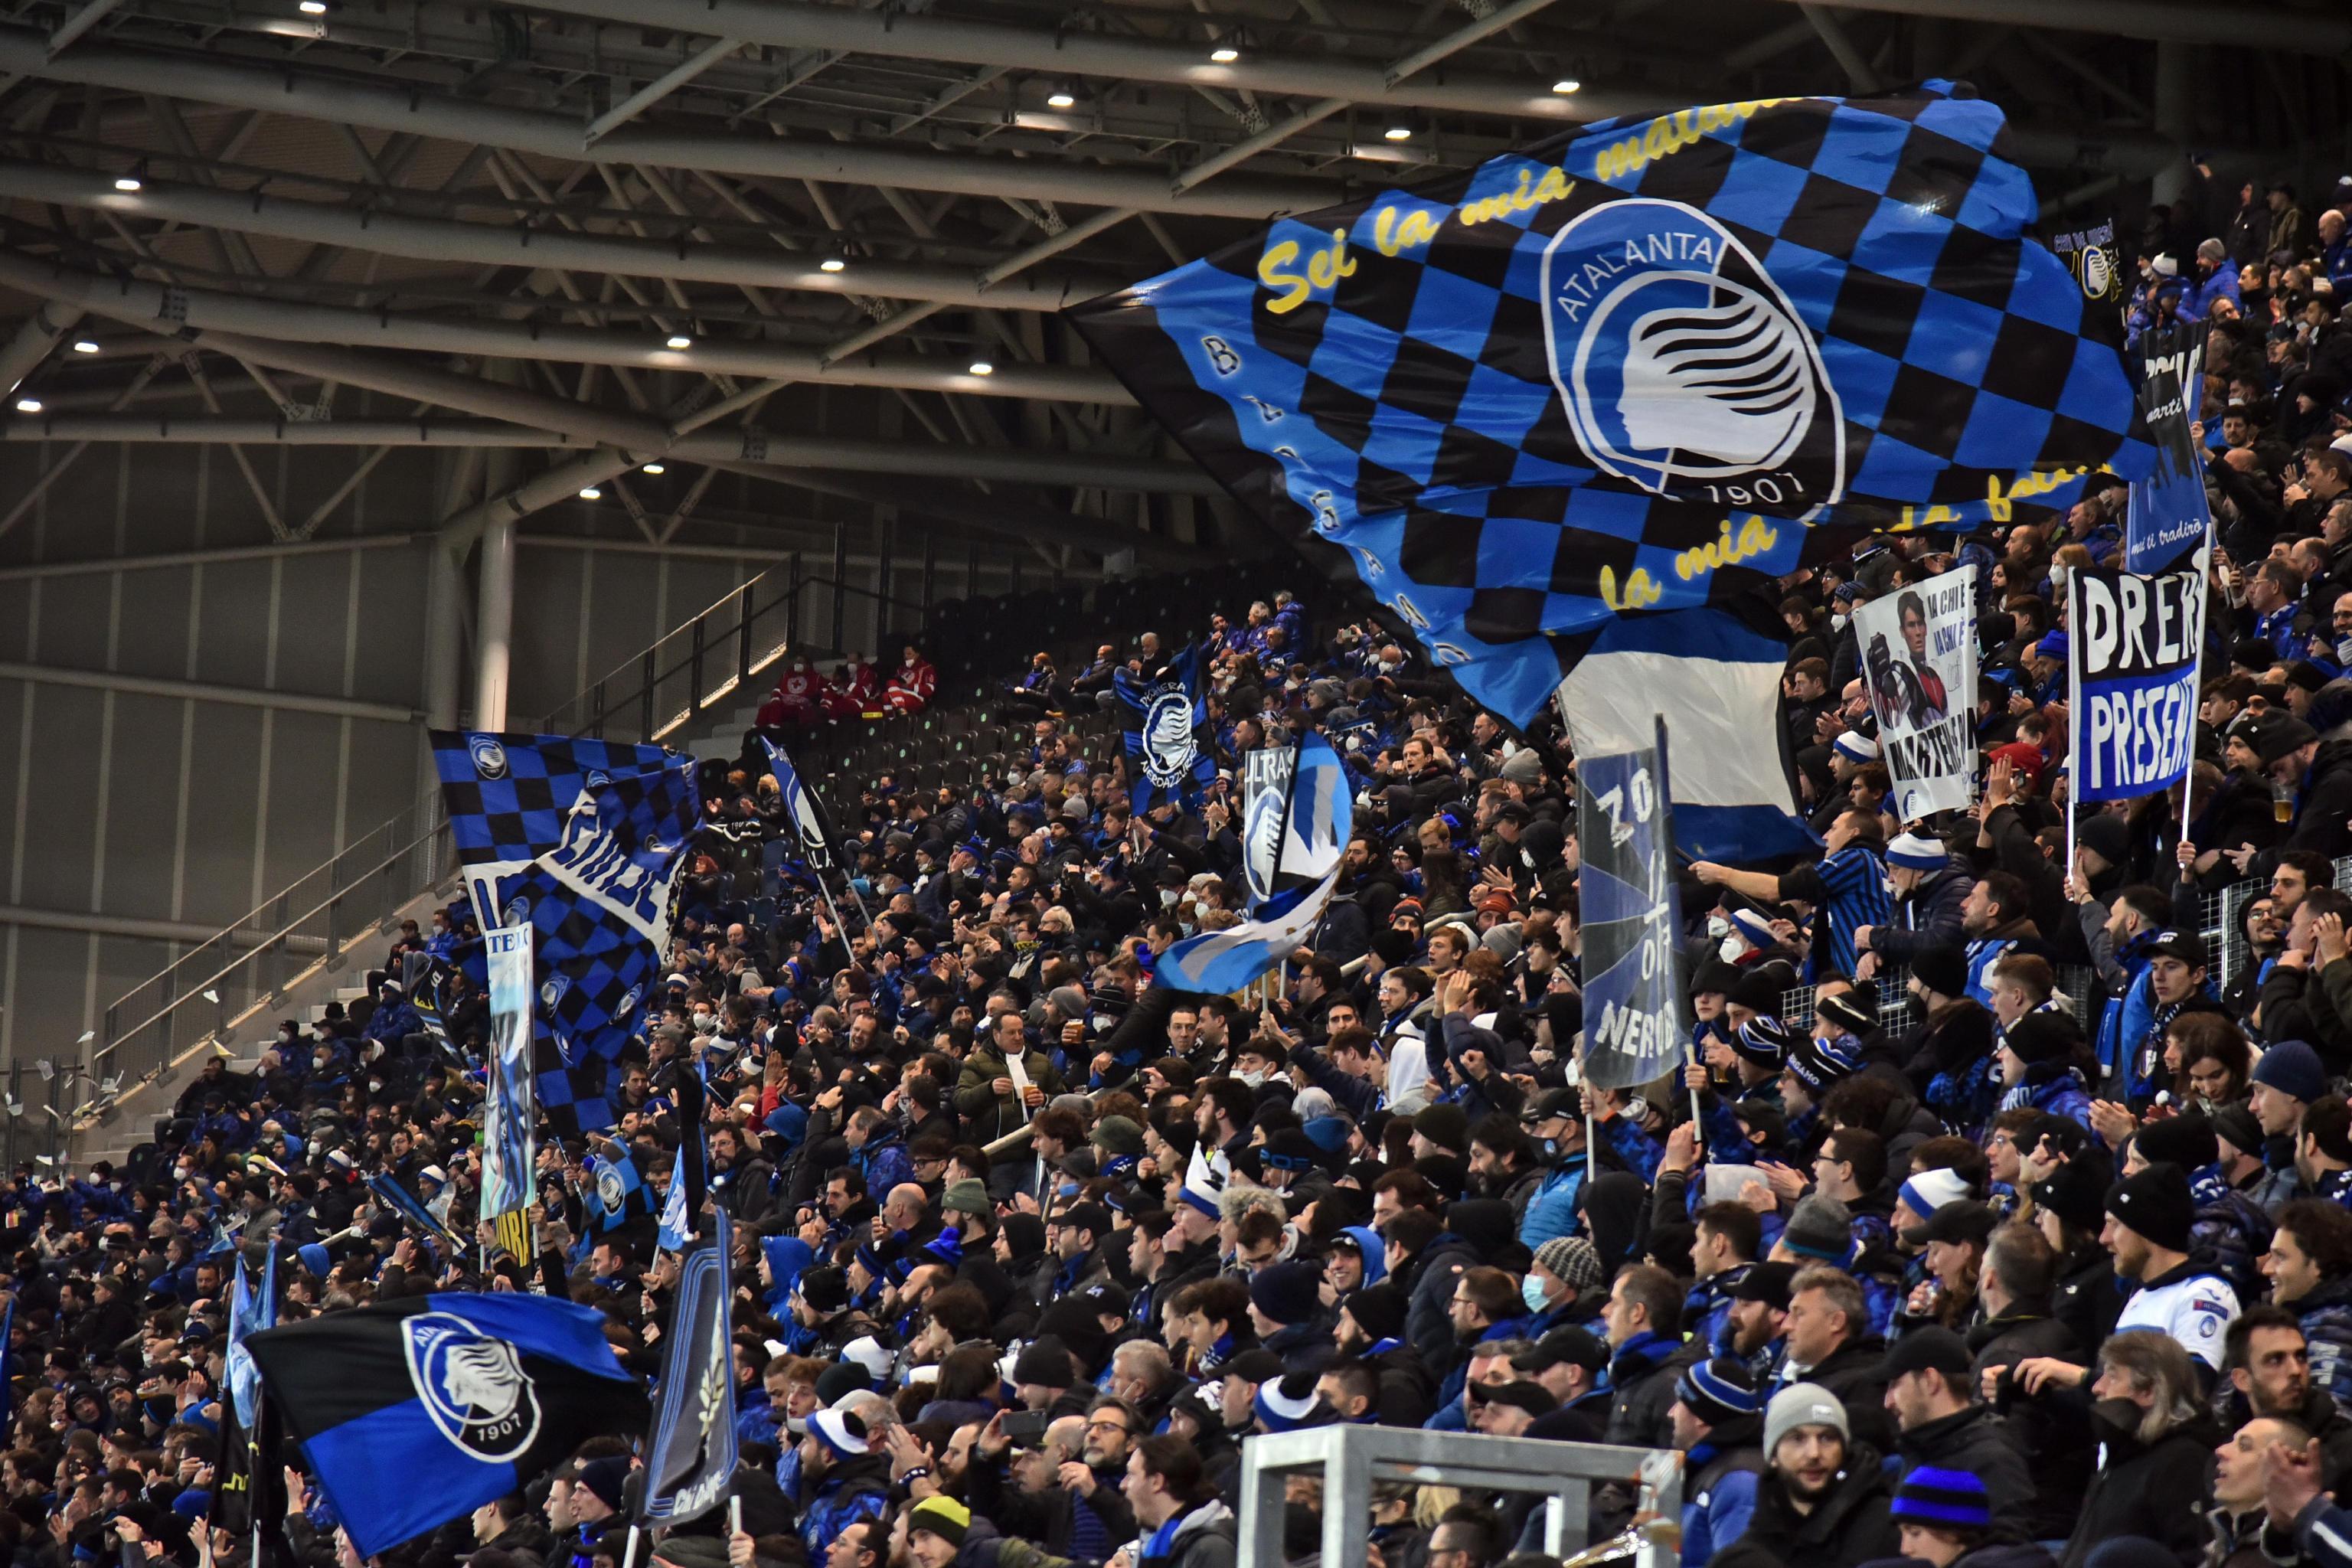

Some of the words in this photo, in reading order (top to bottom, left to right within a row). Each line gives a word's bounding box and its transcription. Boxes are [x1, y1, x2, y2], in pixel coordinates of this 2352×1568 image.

[1257, 227, 1358, 315] Sei
[1374, 205, 1441, 257] la
[1459, 165, 1576, 226] mia
[1557, 232, 1713, 323] ATALANTA
[1703, 472, 1805, 505] 1907
[2159, 518, 2203, 546] tradirò
[1599, 564, 1661, 611] la
[1675, 514, 1777, 581] mia
[1940, 585, 1958, 616] CHI
[477, 1413, 522, 1442] 1907
